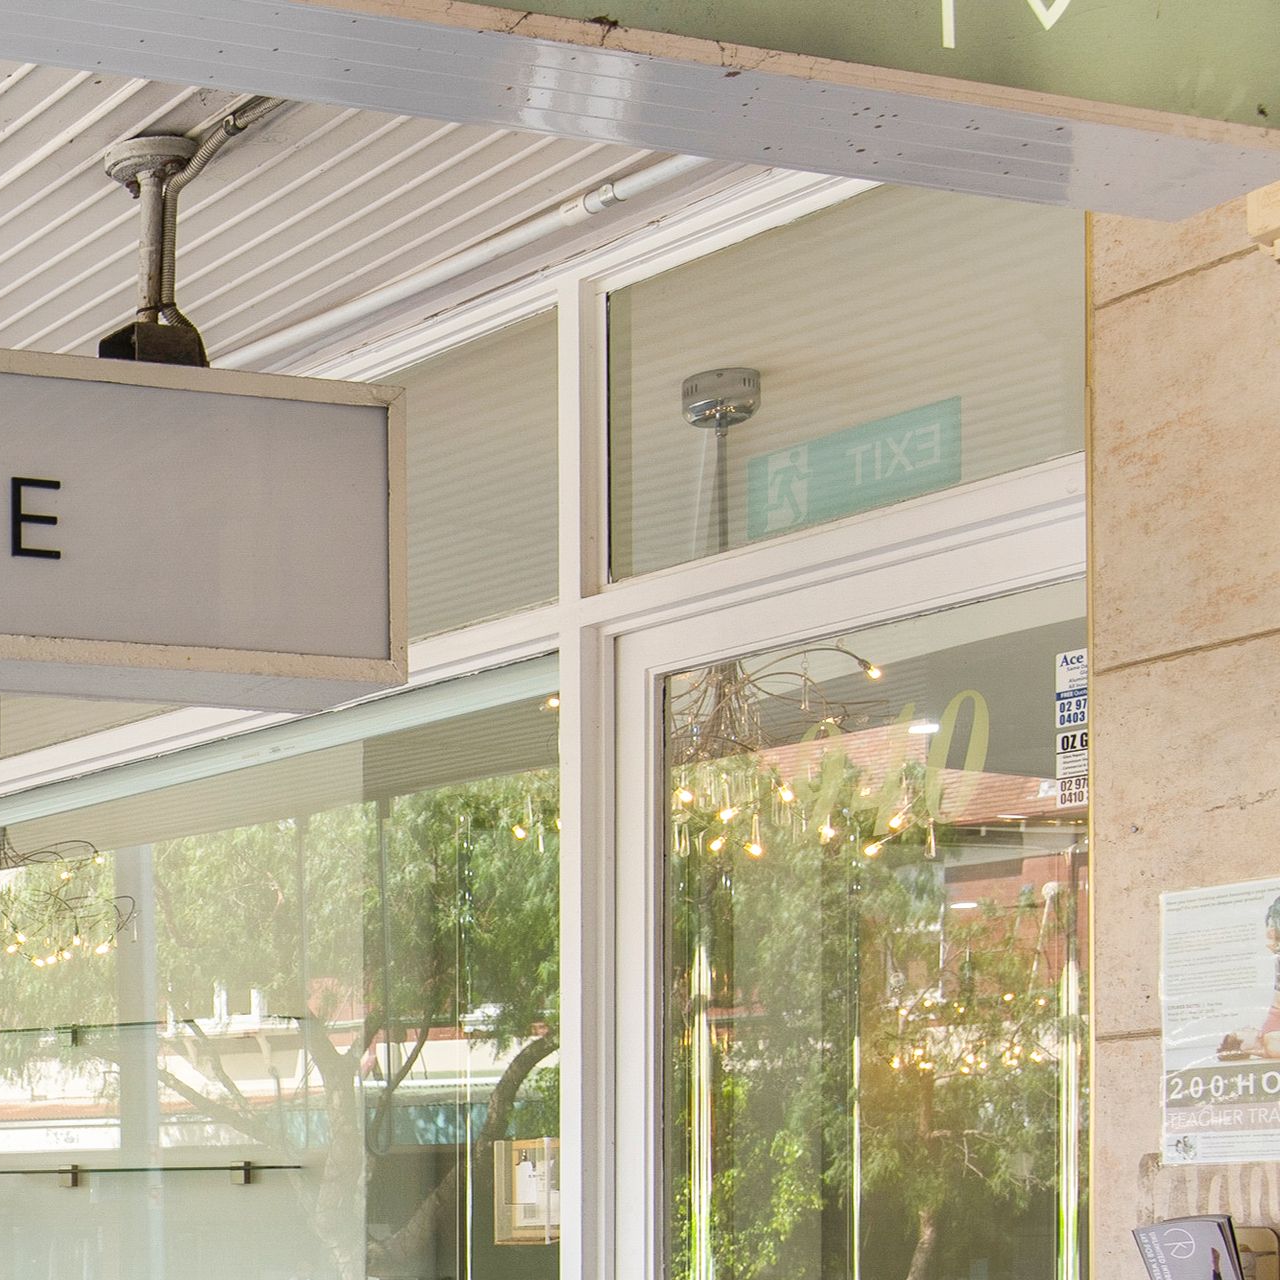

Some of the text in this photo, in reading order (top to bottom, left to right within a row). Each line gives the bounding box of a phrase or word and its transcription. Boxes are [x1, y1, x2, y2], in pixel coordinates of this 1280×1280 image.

[1060, 654, 1084, 667] Ace
[1059, 700, 1072, 713] 02
[1059, 711, 1086, 726] 0403
[1061, 734, 1077, 751] OZ
[1060, 779, 1073, 792] 02
[1060, 791, 1084, 805] 0410
[1169, 1075, 1224, 1100] 200
[1167, 1108, 1244, 1128] TEACHER
